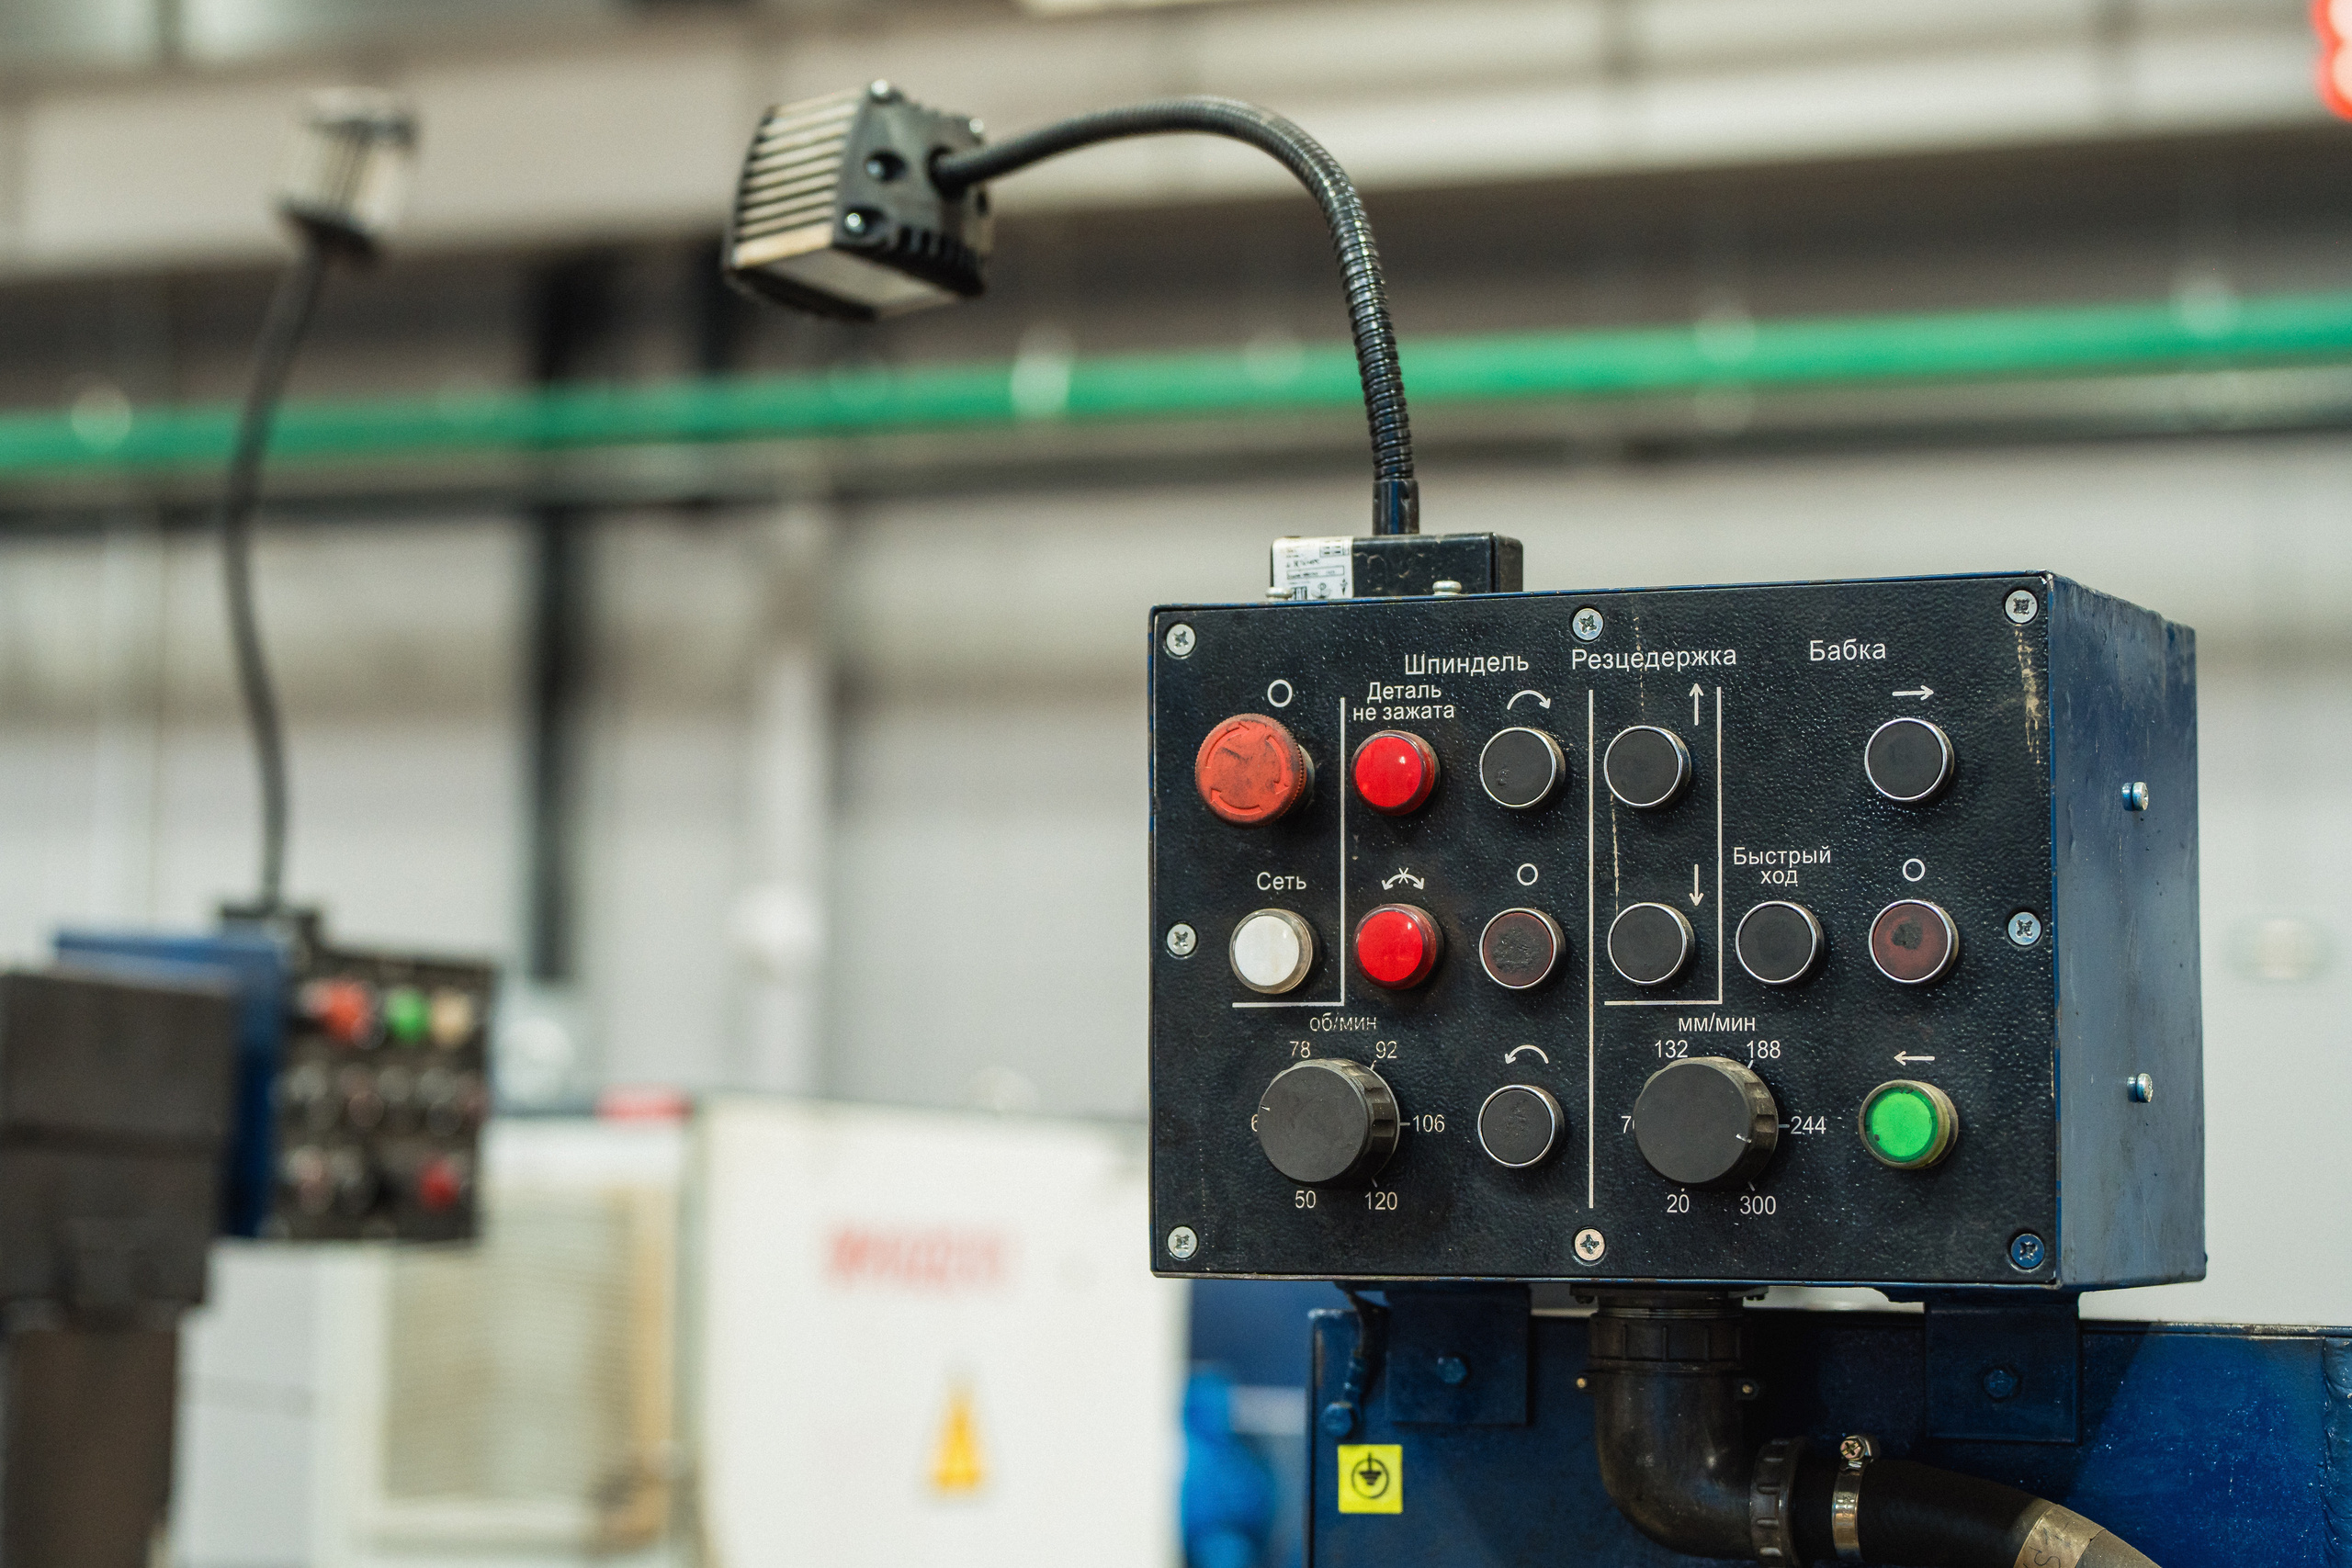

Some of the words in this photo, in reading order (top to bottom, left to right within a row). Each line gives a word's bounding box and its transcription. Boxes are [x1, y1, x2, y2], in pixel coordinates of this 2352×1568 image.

[1572, 647, 1737, 671] Резцедержка
[1809, 637, 1886, 661] Бабка
[1404, 653, 1530, 676] Шпиндель
[1366, 682, 1442, 702] Деталь
[1352, 706, 1377, 721] не
[1382, 705, 1454, 721] зажата
[1733, 845, 1831, 869] Быстрый
[1256, 872, 1307, 891] Сеть
[1760, 869, 1799, 887] ход
[1309, 1012, 1377, 1032] об/мин
[1678, 1011, 1756, 1032] мм/мин
[1289, 1040, 1311, 1059] 78
[1375, 1040, 1397, 1059] 92
[1654, 1039, 1689, 1058] 132
[1746, 1040, 1781, 1059] 188
[1412, 1113, 1445, 1133] 106
[1621, 1115, 1635, 1134] 7
[1791, 1115, 1827, 1134] 244
[1295, 1190, 1317, 1209] 50
[1364, 1191, 1397, 1211] 120
[1666, 1193, 1690, 1213] 20
[1739, 1195, 1777, 1215] 300
